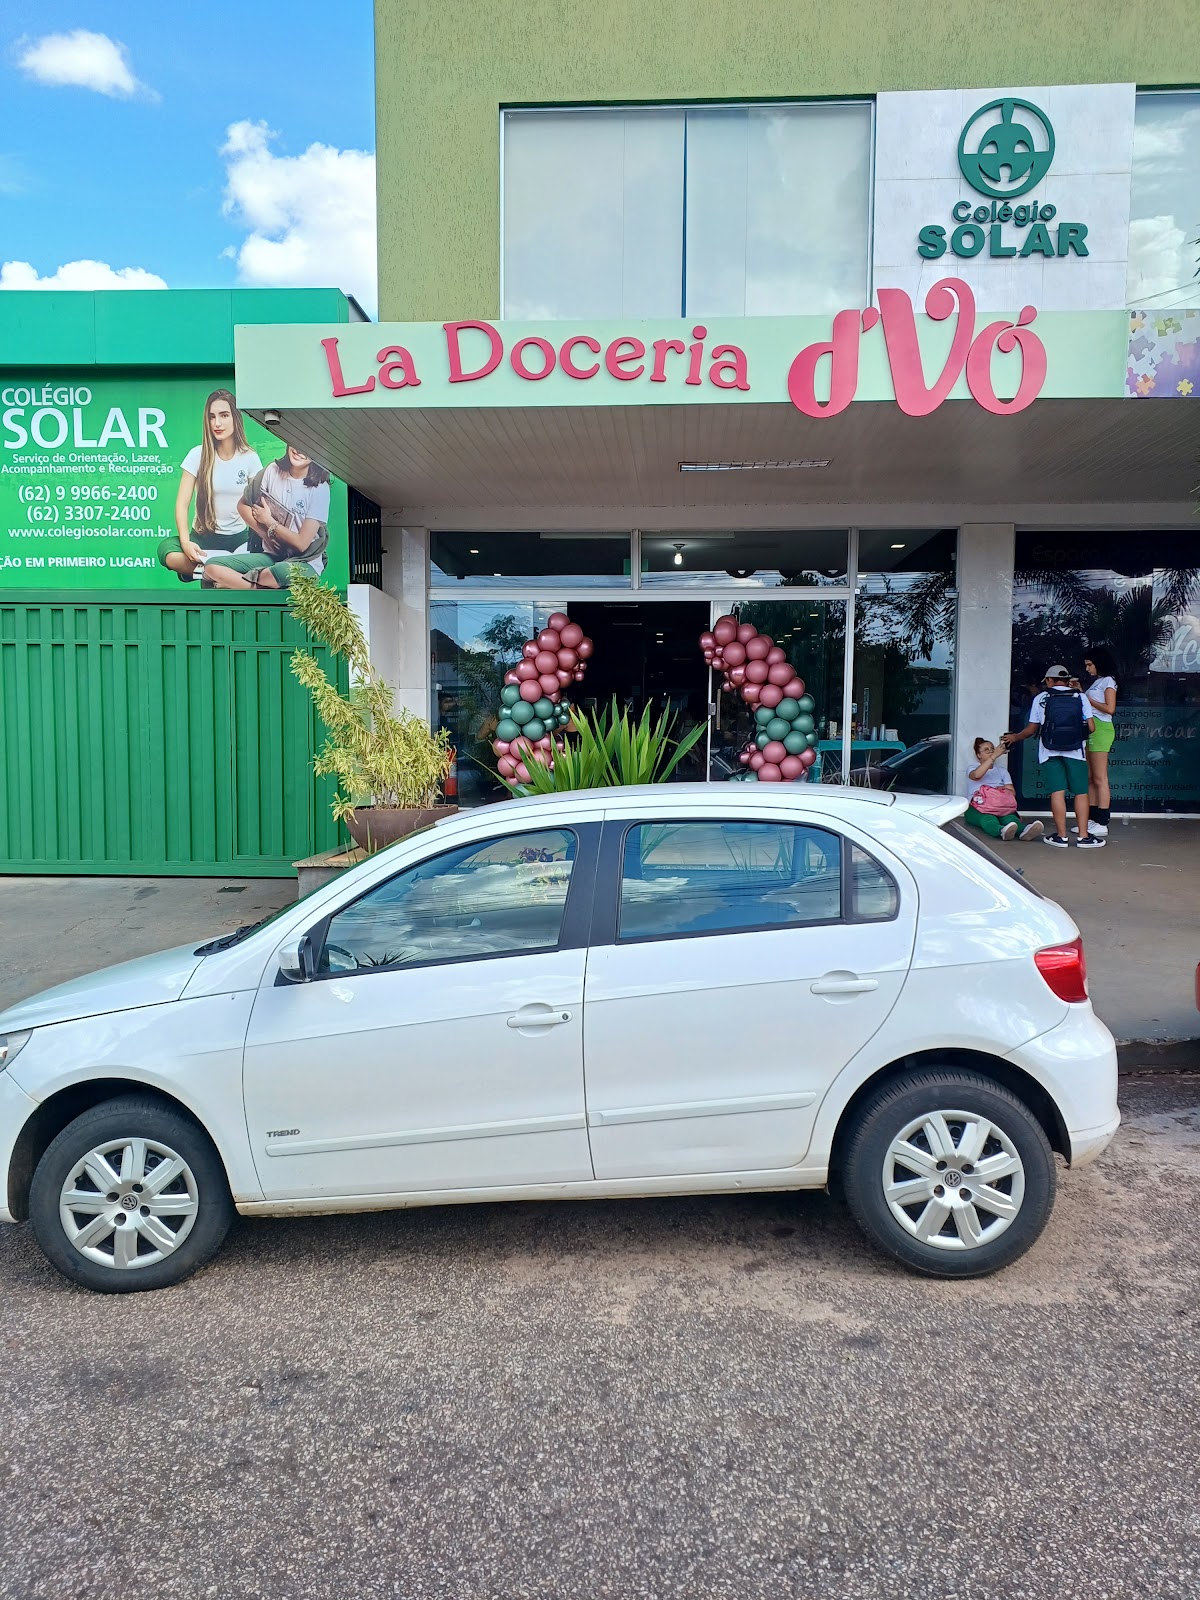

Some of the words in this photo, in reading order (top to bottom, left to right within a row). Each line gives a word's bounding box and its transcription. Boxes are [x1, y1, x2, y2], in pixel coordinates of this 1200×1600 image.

[952, 200, 1057, 226] Colégio
[917, 222, 1090, 259] SOLAR
[320, 337, 421, 398] La
[443, 319, 750, 391] Doceria
[1, 383, 92, 406] COLÉGIO
[2, 407, 169, 449] SOLAR
[12, 453, 50, 465] Serviço
[52, 453, 66, 463] de
[68, 452, 129, 465] Orientação,
[131, 452, 161, 464] Lazer,
[1, 464, 96, 476] Acompanhamento
[98, 465, 105, 473] e
[108, 463, 174, 475] Recuperação
[18, 485, 51, 504] (62)
[55, 486, 66, 501] 9
[70, 485, 158, 501] 9966-2400
[27, 505, 59, 523] (62)
[64, 505, 151, 521] 3307-2400
[8, 525, 172, 540] www.colegiosolar.com.br
[25, 557, 45, 568] EM
[48, 556, 106, 568] PRIMEIRO
[109, 556, 156, 568] LUGAR!
[266, 1128, 301, 1138] TREND
